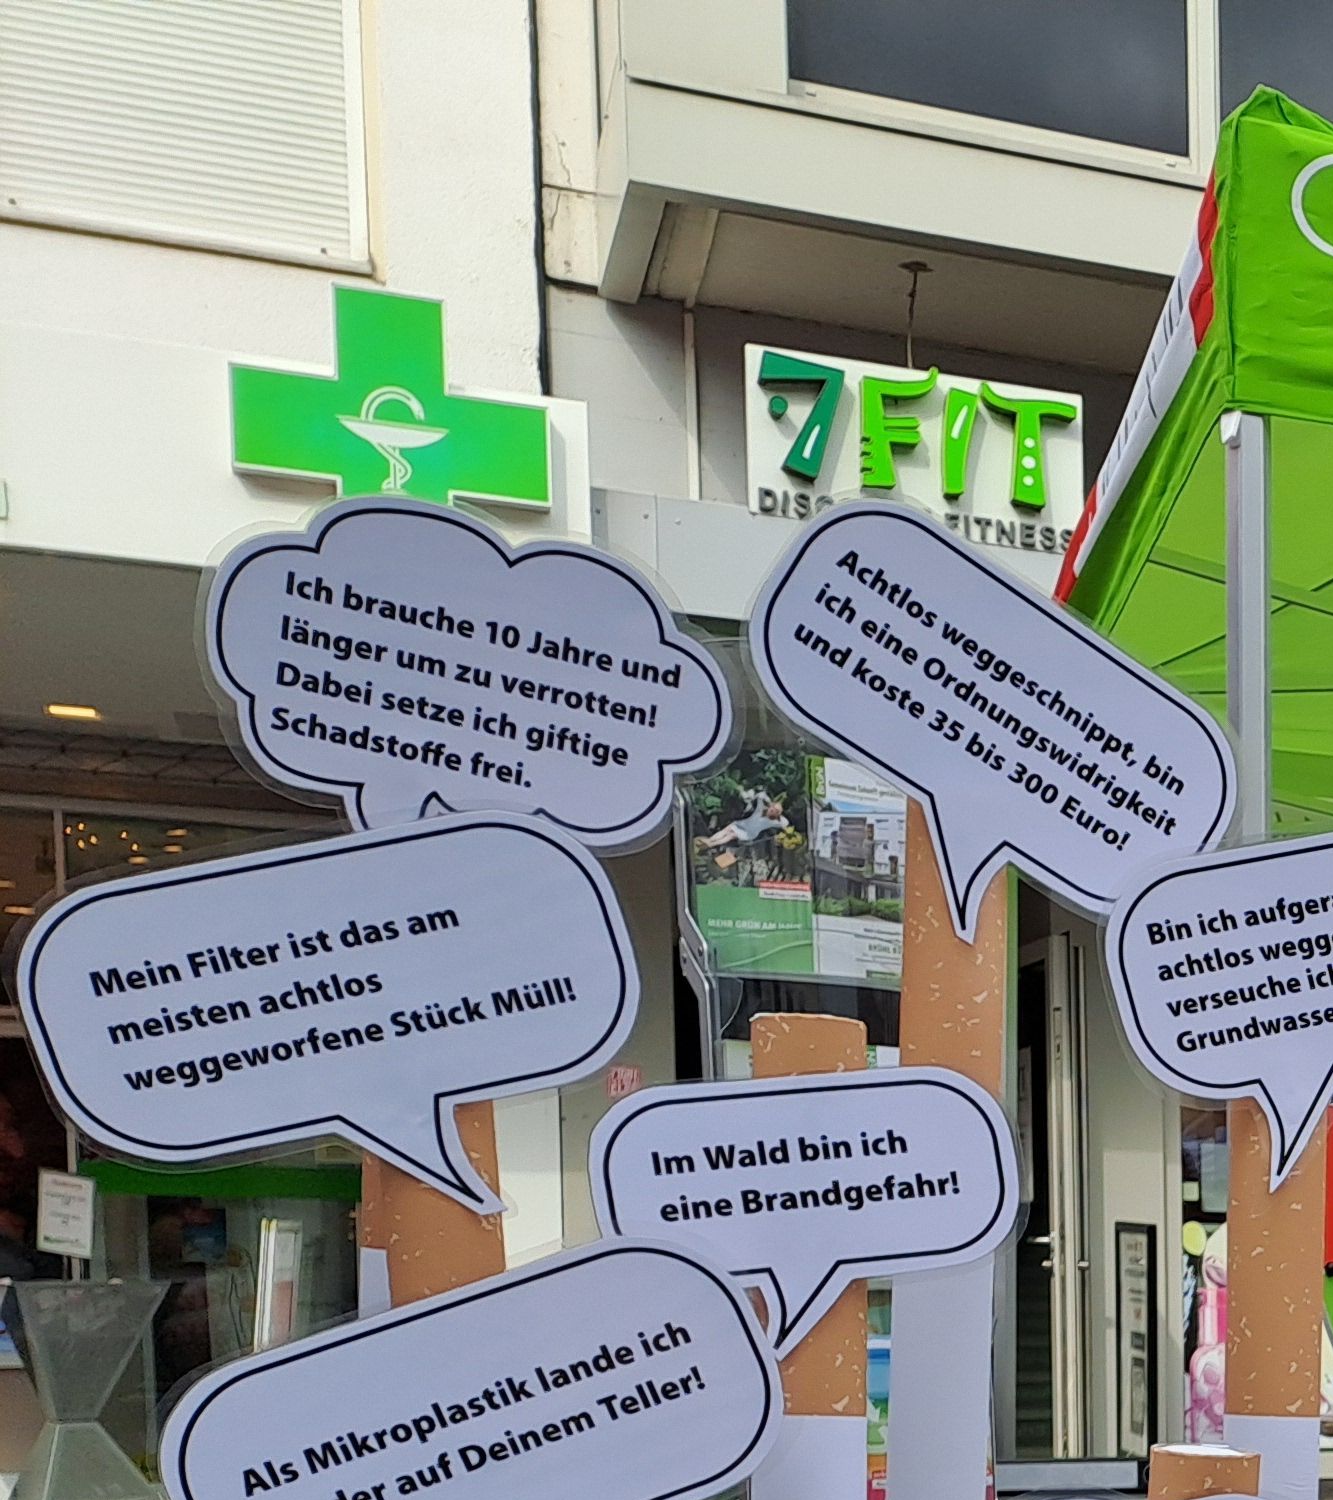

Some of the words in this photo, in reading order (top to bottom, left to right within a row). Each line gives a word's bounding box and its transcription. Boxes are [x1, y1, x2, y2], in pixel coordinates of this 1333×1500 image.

[758, 350, 1077, 510] 7FIT
[280, 614, 388, 662] länger
[396, 649, 445, 677] um
[454, 663, 491, 688] zu
[500, 674, 656, 727] verrotten!
[285, 570, 332, 604] Ich
[342, 583, 474, 638] brauche
[485, 621, 520, 648] 10
[526, 631, 612, 672] Jahre
[621, 659, 681, 688] und
[835, 550, 937, 627] Achtlos
[941, 621, 1136, 767] weggeschnippt,
[1142, 754, 1184, 795] bin
[270, 707, 461, 771] Schadstoffe
[470, 751, 531, 787] frei.
[276, 661, 372, 705] Dabei
[380, 692, 464, 726] setze
[472, 706, 516, 739] ich
[525, 723, 628, 767] giftige
[793, 623, 852, 669] und
[850, 657, 924, 719] koste
[927, 709, 965, 741] 35
[964, 731, 1005, 770] bis
[1007, 761, 1058, 803] 300
[1059, 795, 1130, 851] Euro!
[814, 582, 856, 624] ich
[860, 619, 918, 665] eine
[923, 657, 1176, 835] Ordnungswidrigkeit
